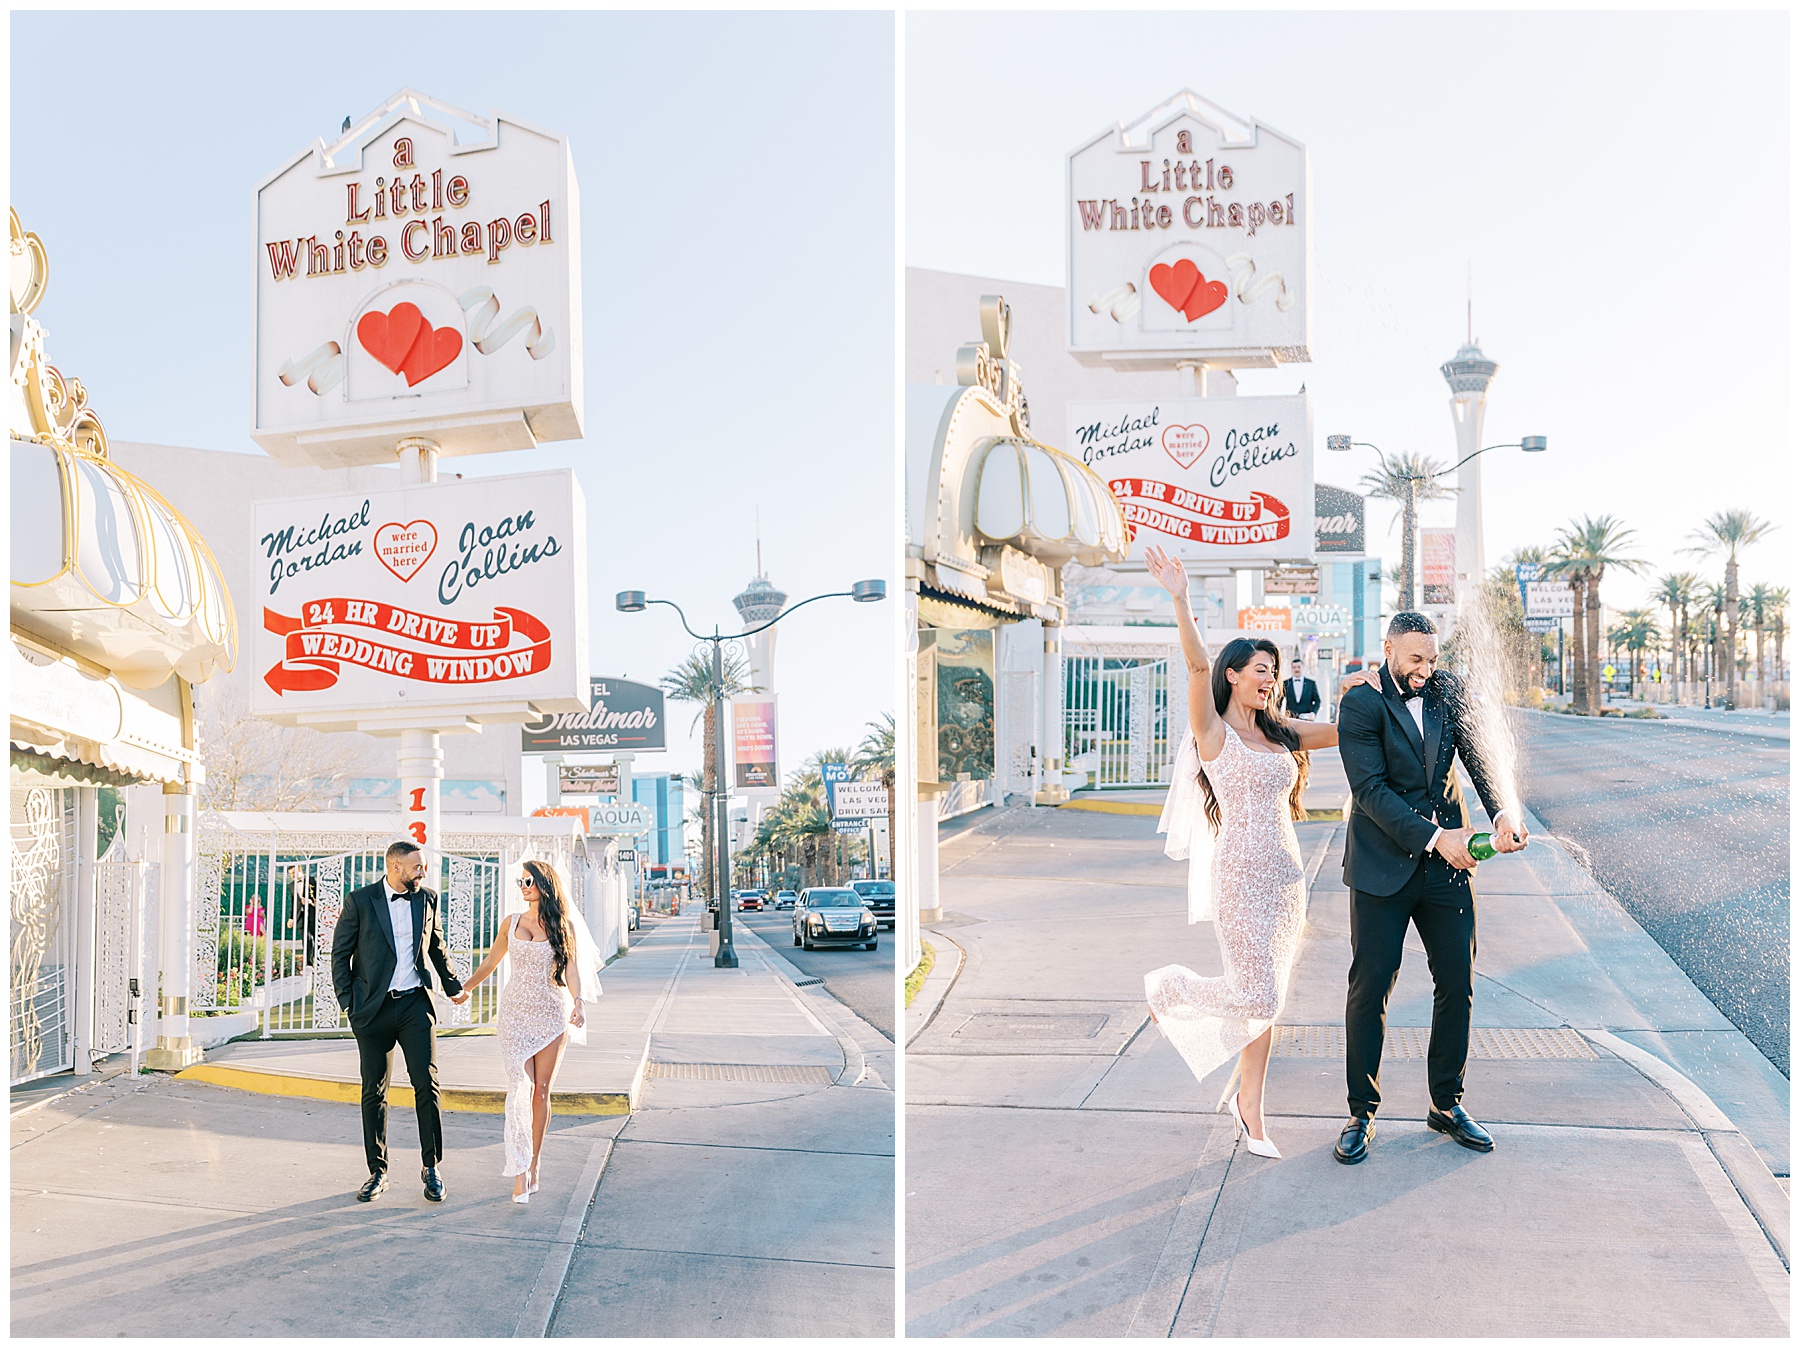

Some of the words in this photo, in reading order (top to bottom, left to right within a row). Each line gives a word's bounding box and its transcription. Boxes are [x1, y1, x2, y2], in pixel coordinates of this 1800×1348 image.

[392, 136, 416, 170] a
[1176, 130, 1193, 154] a
[1140, 158, 1234, 193] Little
[346, 168, 470, 225] Little
[1077, 197, 1172, 231] White
[1182, 193, 1295, 237] Chapel
[265, 230, 388, 282] White
[400, 199, 553, 265] Chapel
[1076, 406, 1160, 444] Michael
[1225, 422, 1280, 462] Joan
[1083, 436, 1154, 466] Jordan
[1169, 440, 1203, 448] married
[1176, 450, 1195, 458] here
[1209, 442, 1298, 488] Collins
[1113, 481, 1133, 497] 24
[1140, 481, 1166, 500] HR
[1172, 488, 1225, 517] DRIVE
[1232, 503, 1256, 521] UP
[261, 499, 370, 558] Michael
[391, 531, 418, 542] were
[458, 509, 536, 570] Joan
[1200, 523, 1278, 543] WINDOW
[382, 542, 428, 556] married
[392, 555, 418, 567] here
[269, 541, 363, 595] Jordan
[438, 535, 562, 605] Collins
[308, 602, 334, 624] 24
[345, 601, 379, 626] HR
[386, 615, 458, 645] DRIVE
[470, 624, 501, 648] UP
[1243, 621, 1286, 631] HOTEL
[1295, 612, 1341, 624] AQUA
[300, 634, 414, 675] WEDDING
[427, 649, 534, 681] WINDOW
[560, 735, 580, 746] LAS
[581, 734, 618, 745] VEGAS
[568, 766, 610, 778] Shalimar
[593, 810, 642, 825] AQUA
